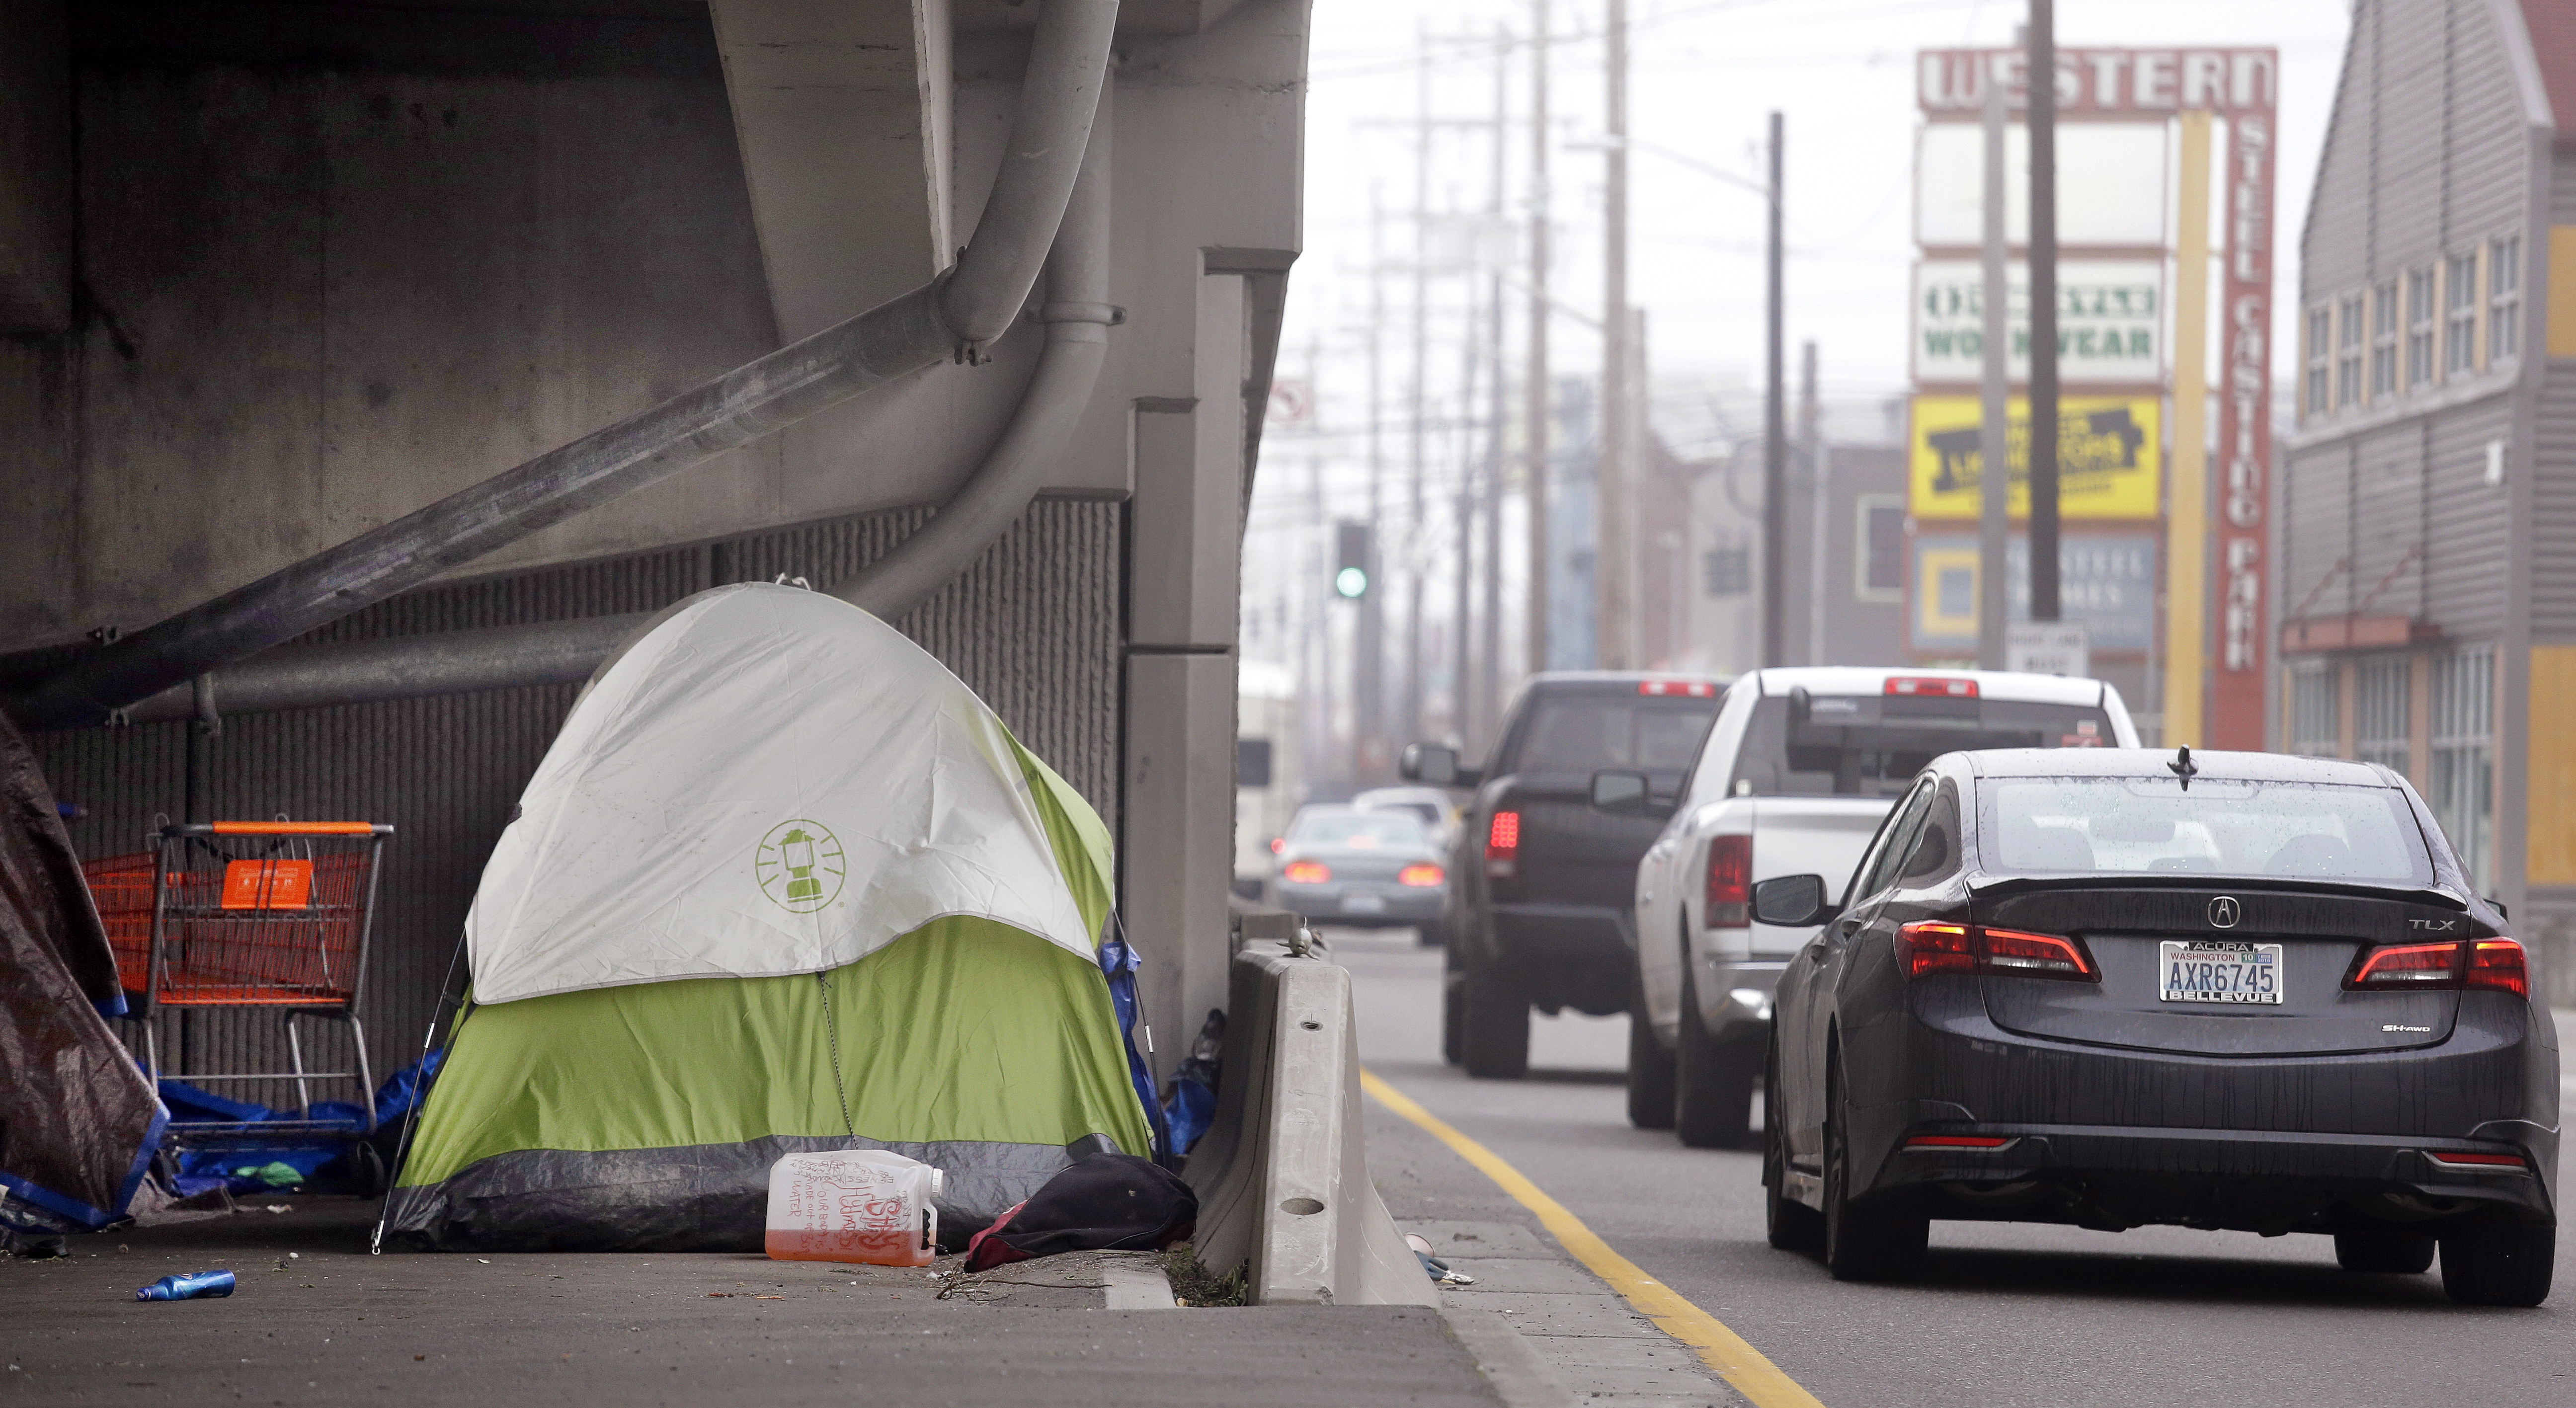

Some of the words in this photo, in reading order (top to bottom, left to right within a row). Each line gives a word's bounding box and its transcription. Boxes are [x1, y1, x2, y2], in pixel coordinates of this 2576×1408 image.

[1921, 51, 2276, 109] WESTERN
[2233, 116, 2268, 284] STEEL
[2409, 919, 2455, 931] TLX
[2171, 952, 2235, 961] WASHINGTON
[2193, 942, 2249, 951] ACURA
[2170, 962, 2273, 992] AXR6745
[2170, 991, 2273, 1002] BELLEVUE
[788, 1180, 802, 1217] WATER
